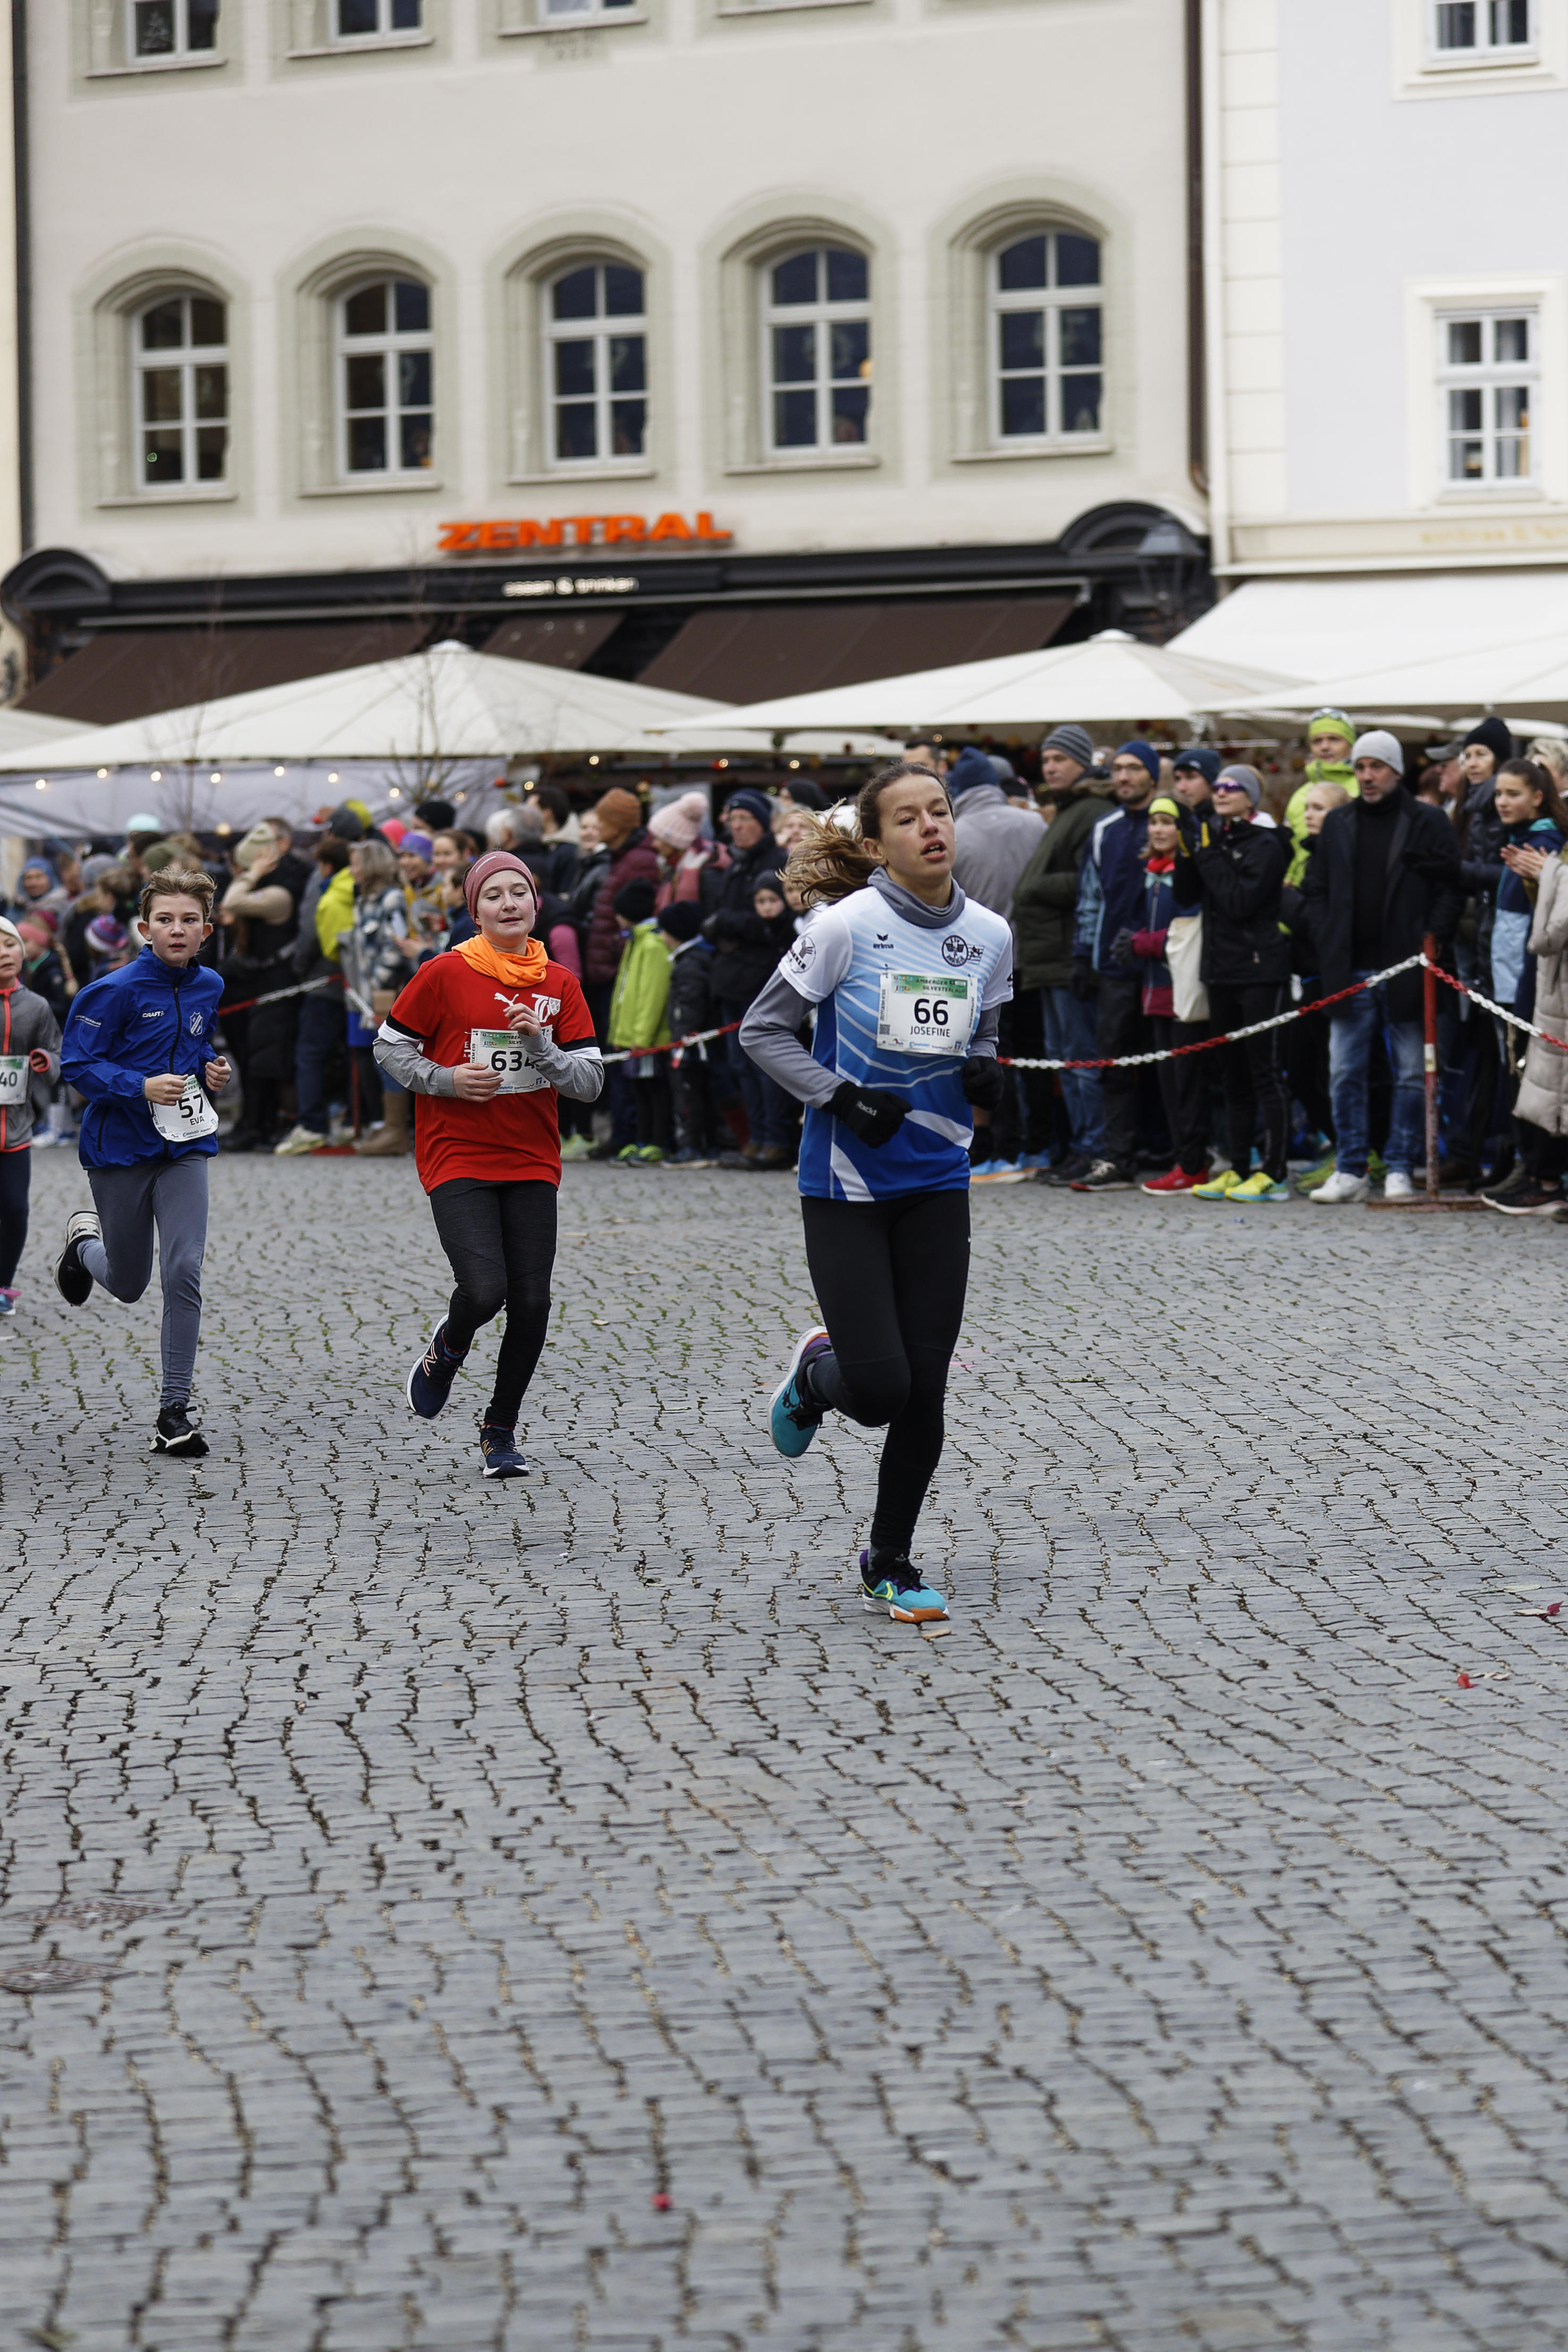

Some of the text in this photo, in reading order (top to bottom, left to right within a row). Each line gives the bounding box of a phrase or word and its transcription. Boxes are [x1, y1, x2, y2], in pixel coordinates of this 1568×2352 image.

[437, 512, 731, 550] ZENTRAL
[914, 998, 948, 1025] 66
[911, 1026, 950, 1037] JOSEFINE
[179, 1093, 204, 1118] 57
[190, 1116, 205, 1126] EVA
